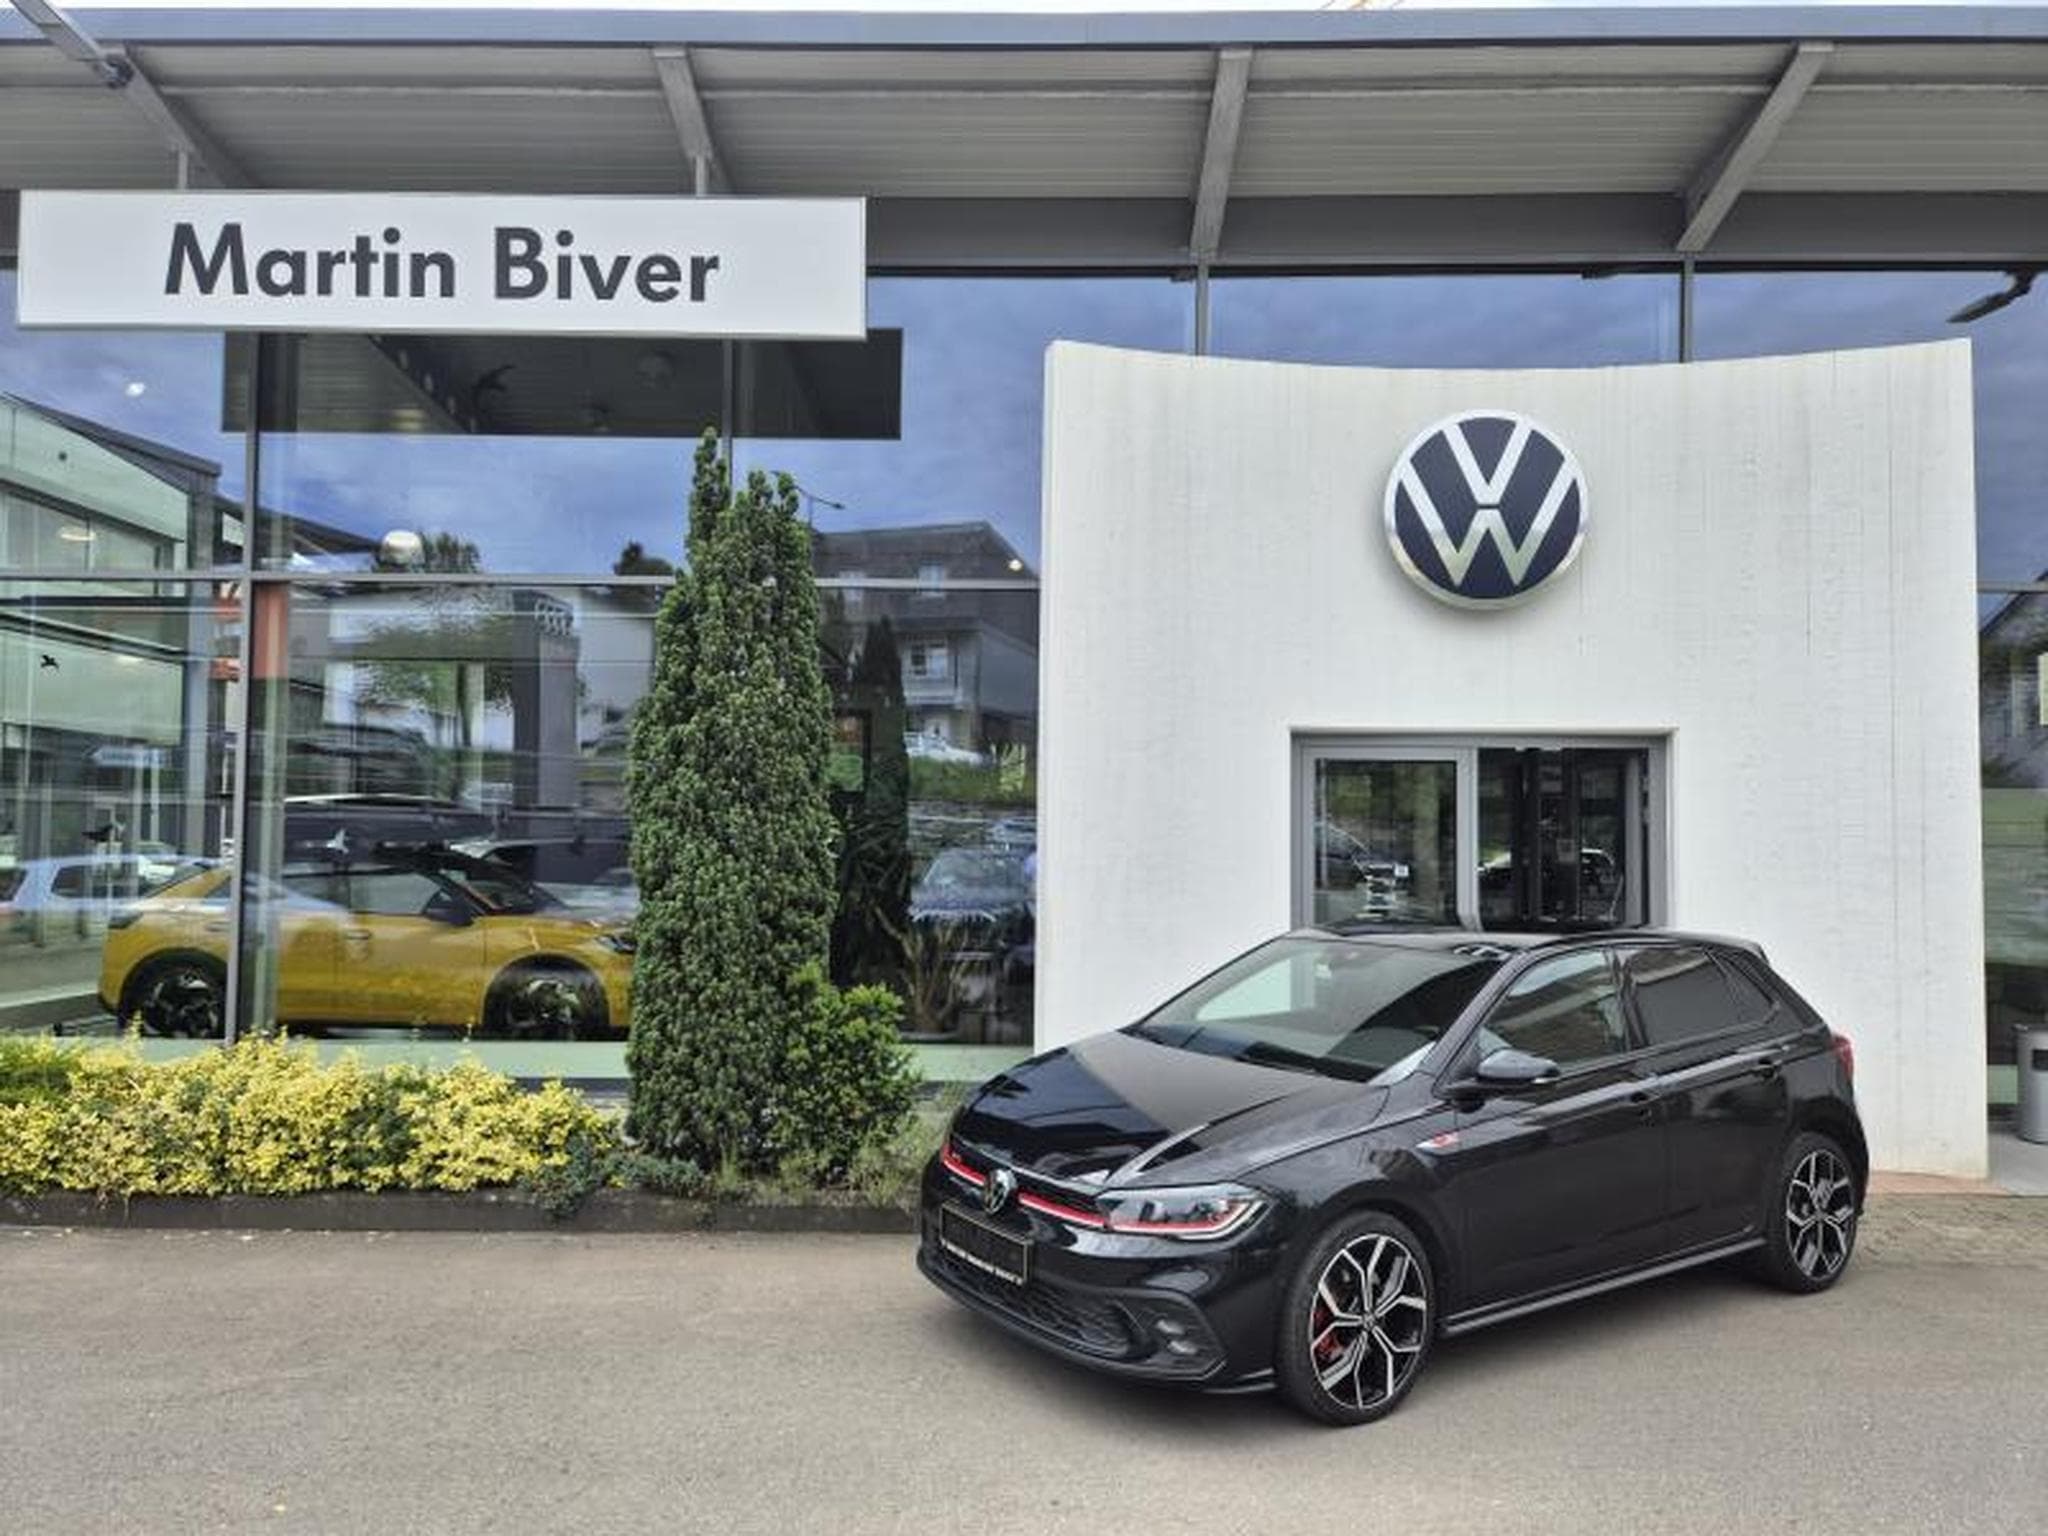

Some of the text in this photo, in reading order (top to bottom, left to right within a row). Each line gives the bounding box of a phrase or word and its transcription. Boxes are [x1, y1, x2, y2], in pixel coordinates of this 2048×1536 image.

[164, 222, 720, 303] Martin Biver
[1394, 413, 1582, 592] VW
